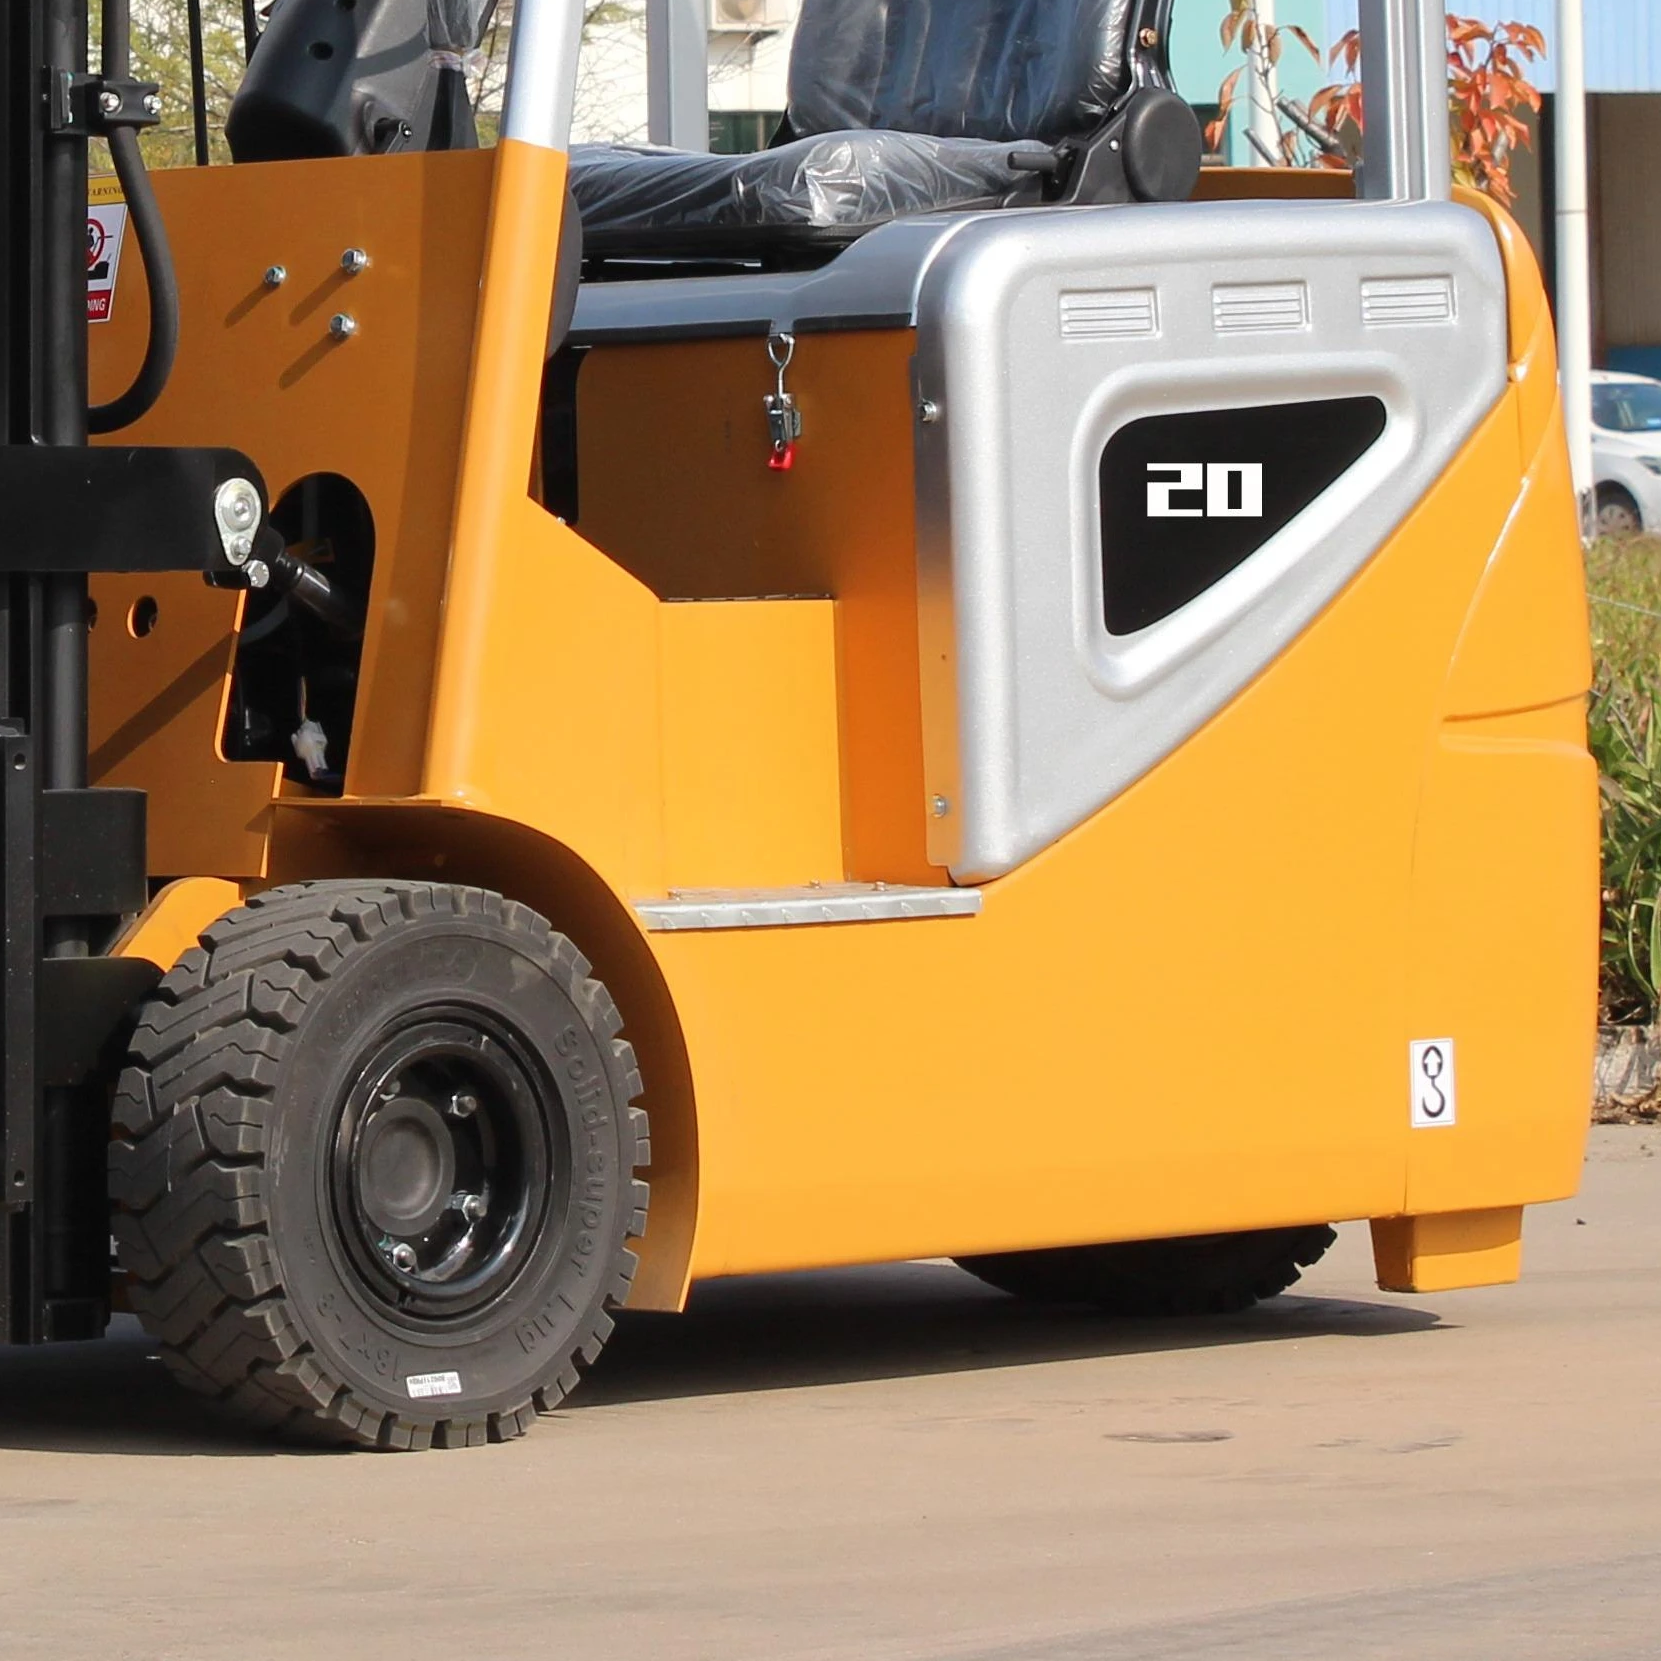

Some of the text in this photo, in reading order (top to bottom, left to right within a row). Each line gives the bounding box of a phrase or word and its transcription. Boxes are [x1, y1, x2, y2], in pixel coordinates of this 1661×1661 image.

[88, 187, 123, 196] ARNING
[1147, 463, 1262, 517] 20
[515, 1024, 609, 1355] Solid-super Lug
